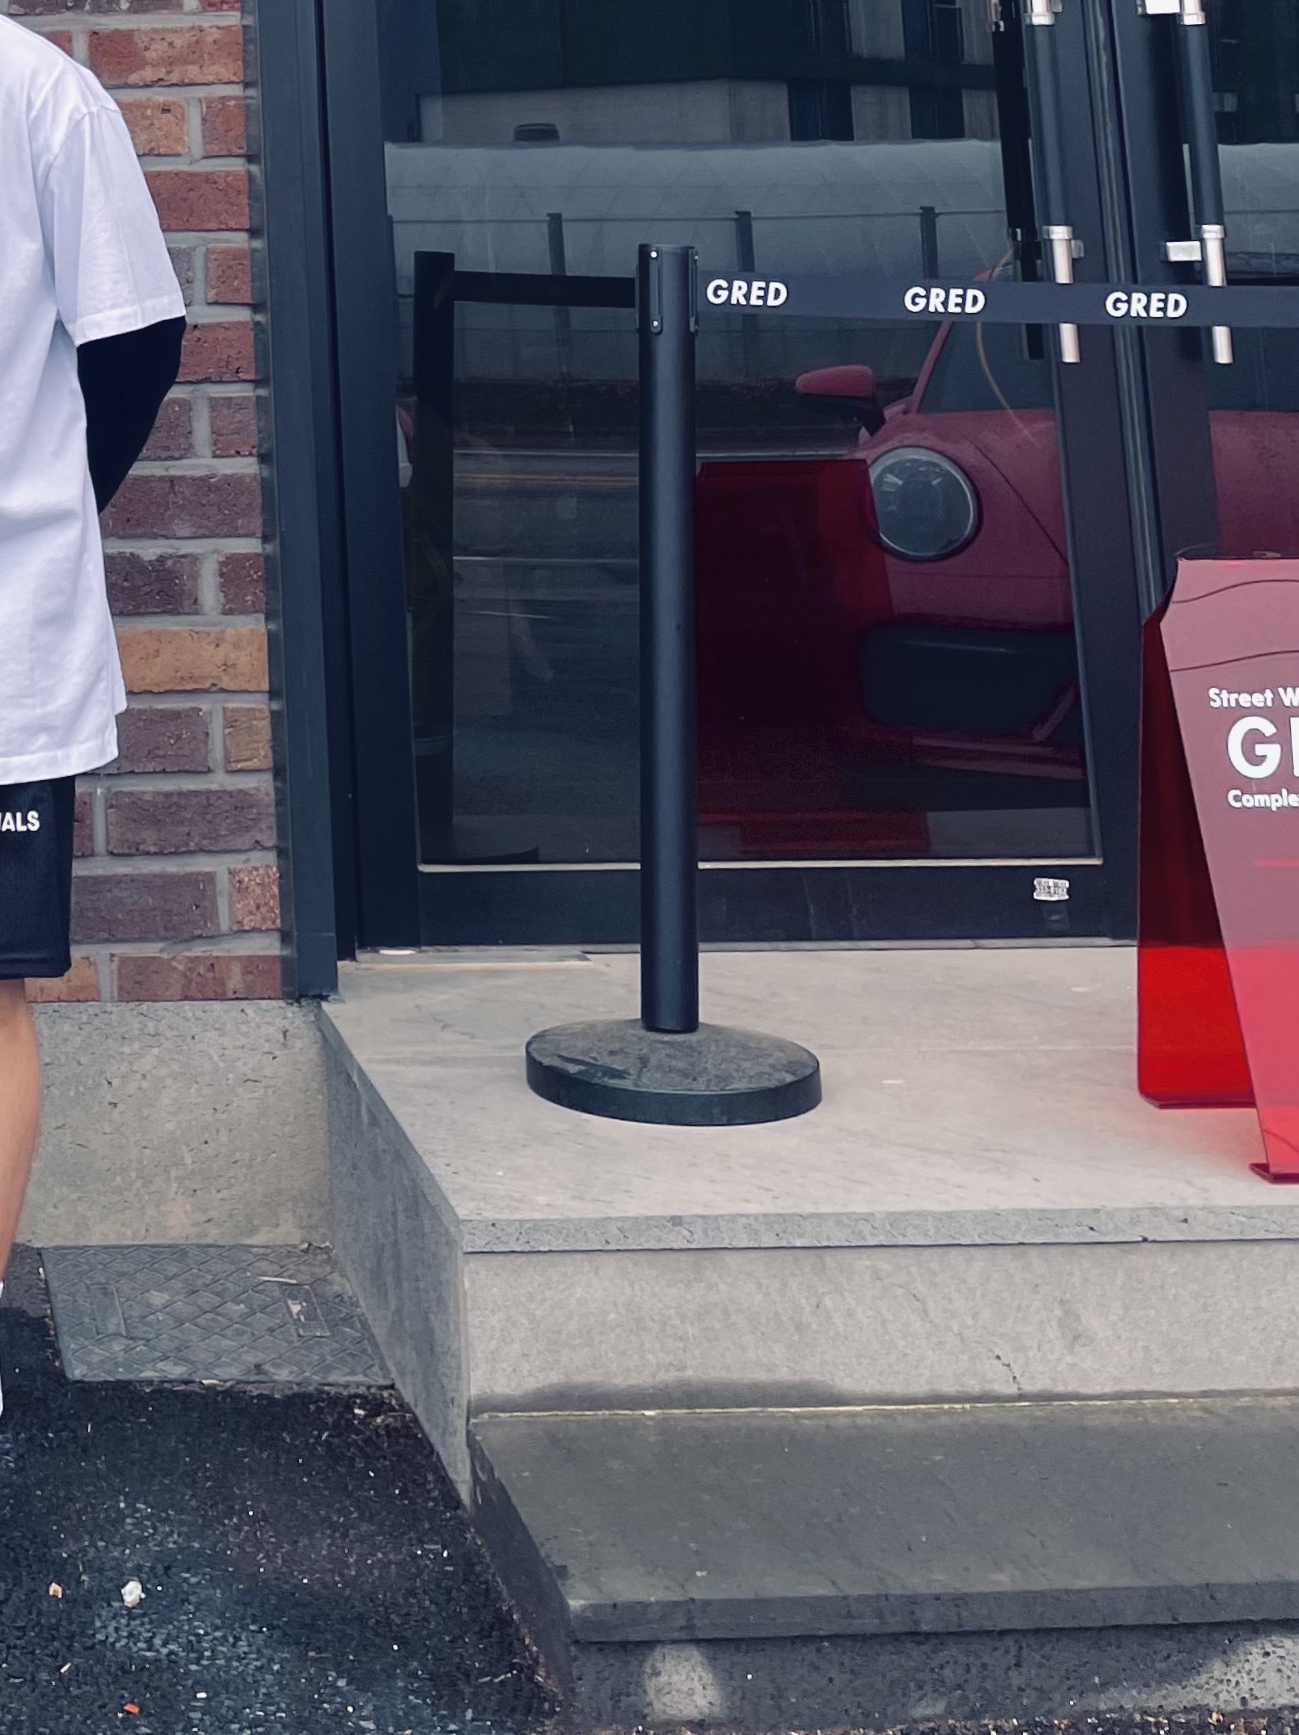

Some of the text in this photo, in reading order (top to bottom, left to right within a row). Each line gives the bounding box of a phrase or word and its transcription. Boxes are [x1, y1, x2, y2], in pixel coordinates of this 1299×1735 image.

[706, 278, 1188, 318] GRED GRED GRED
[1208, 687, 1274, 707] Street
